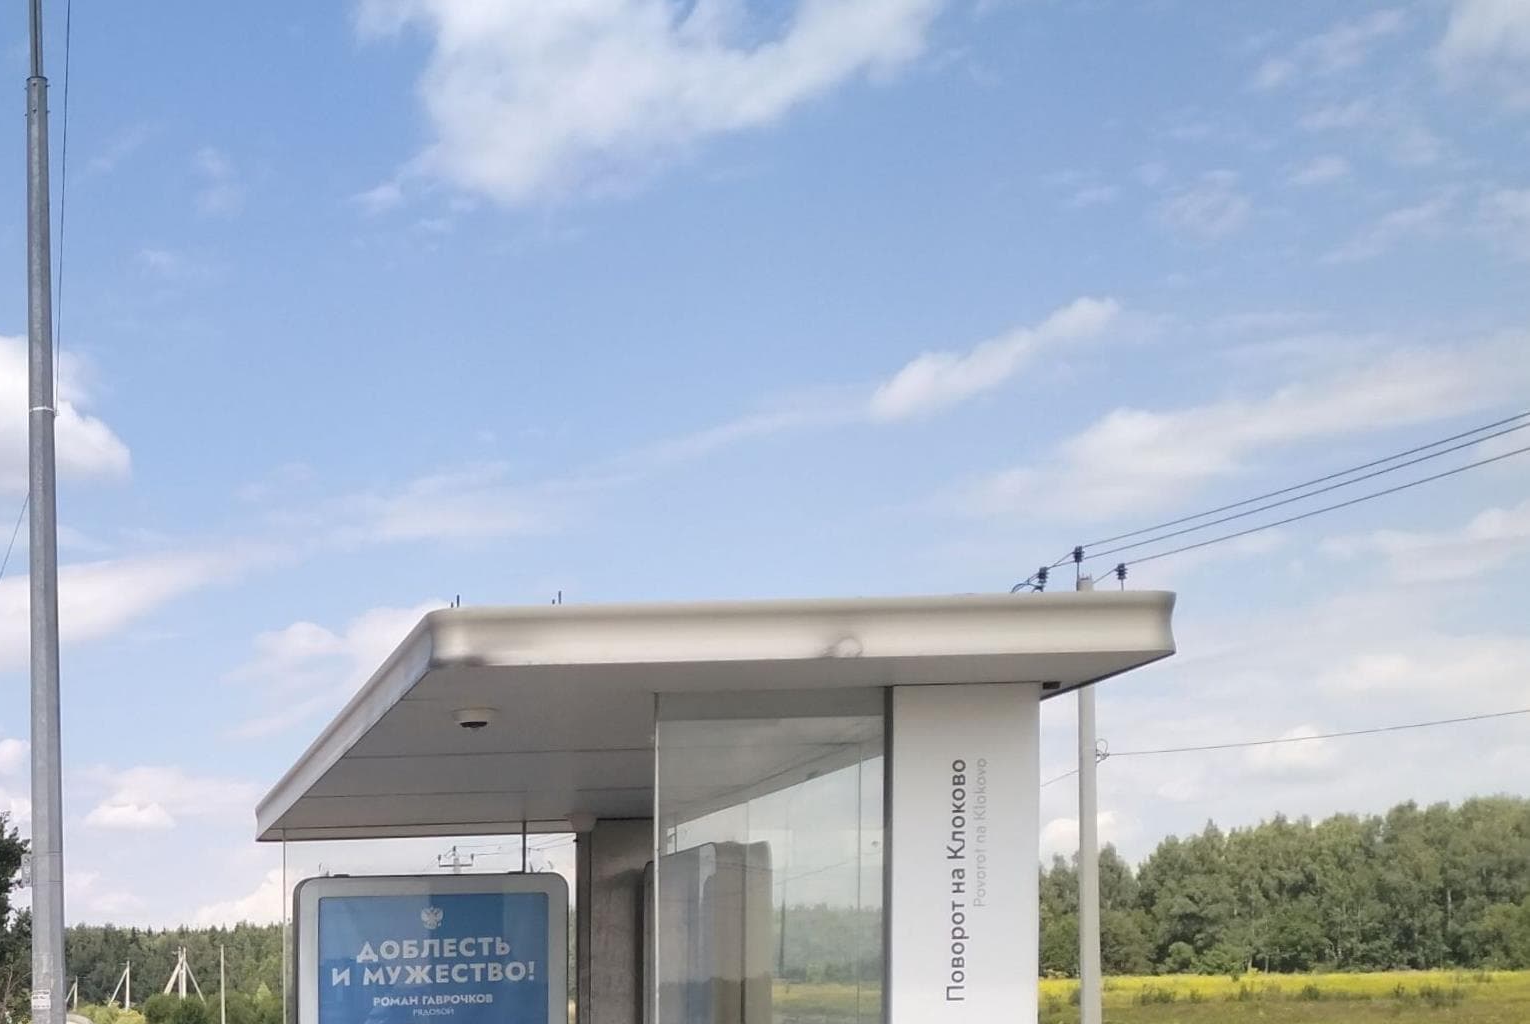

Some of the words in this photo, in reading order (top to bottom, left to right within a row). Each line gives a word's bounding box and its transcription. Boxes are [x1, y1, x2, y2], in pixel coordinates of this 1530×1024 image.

[973, 758, 988, 820] Klokovo
[946, 759, 966, 859] Клоково
[975, 825, 987, 843] na
[952, 868, 966, 893] на
[973, 848, 987, 907] Povorot
[356, 937, 511, 963] ДОБЛЕСТЬ
[946, 900, 969, 1001] Поворот
[332, 967, 351, 987] И
[363, 961, 535, 986] МУЖЕСТВО!
[373, 996, 419, 1007] РОМАН
[422, 993, 493, 1005] ГАВРОЧКОВ
